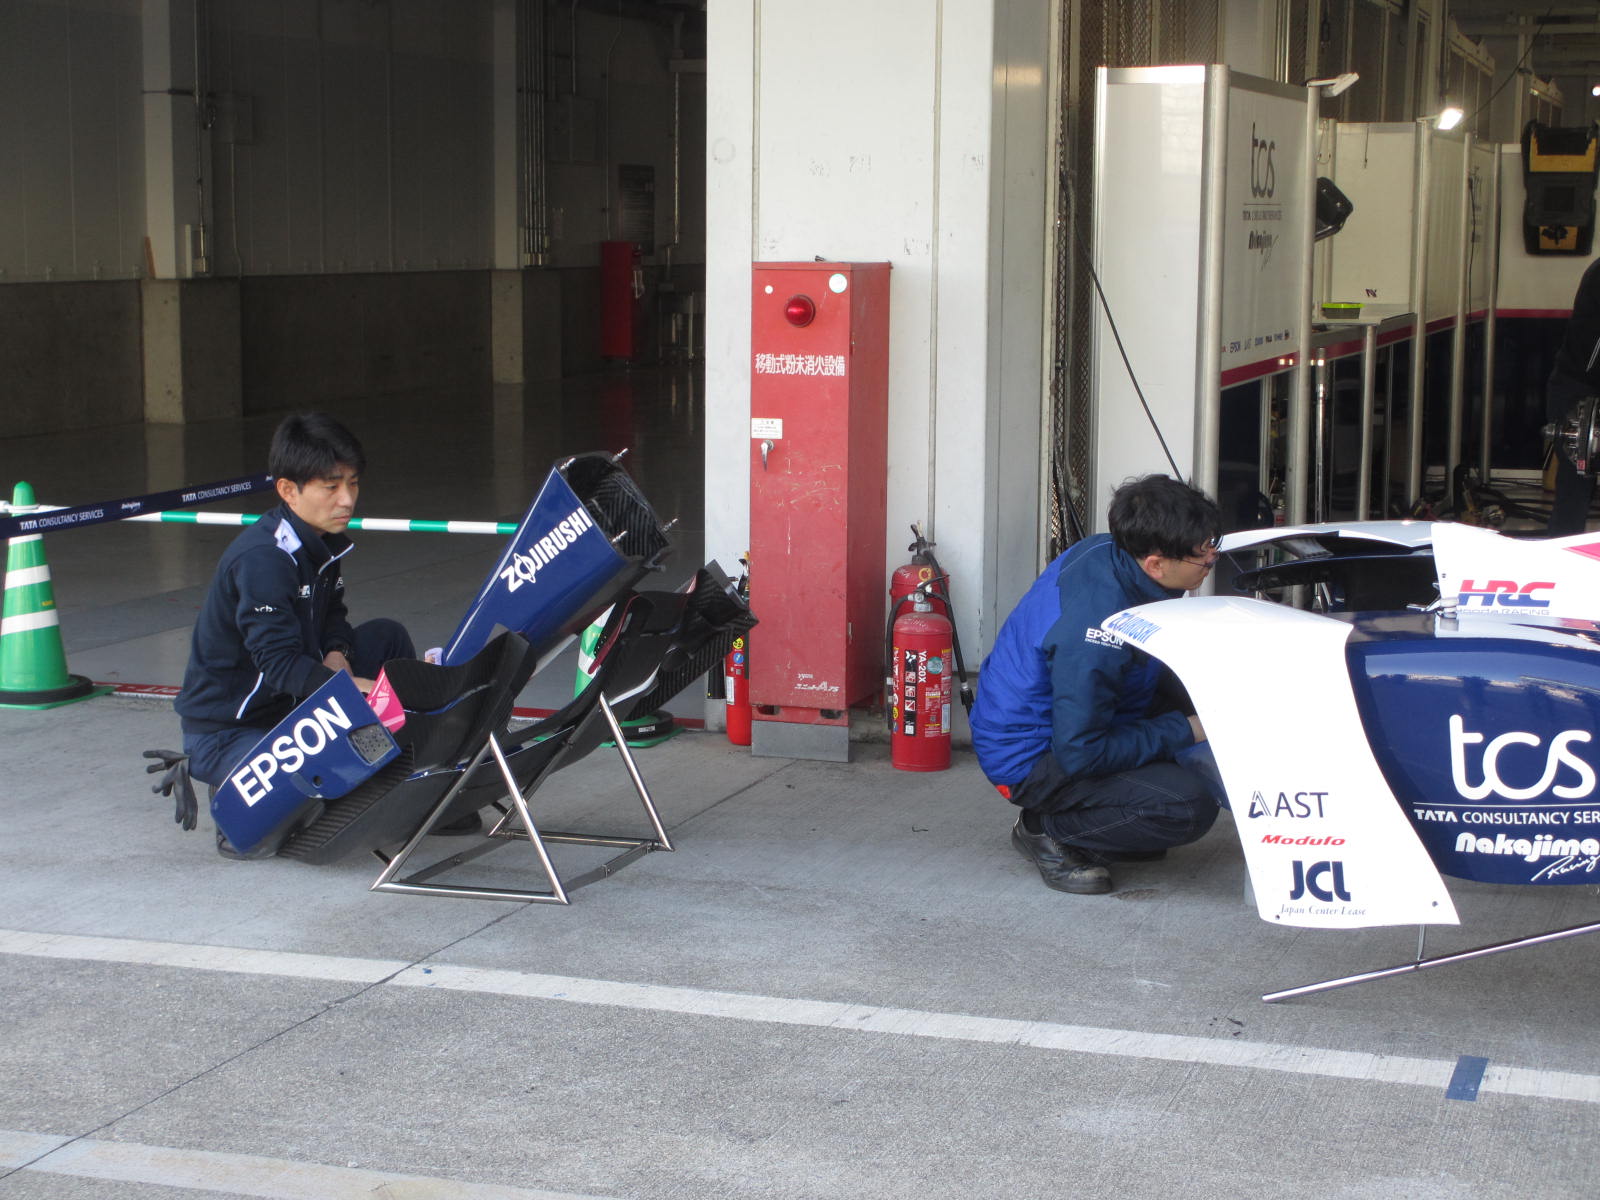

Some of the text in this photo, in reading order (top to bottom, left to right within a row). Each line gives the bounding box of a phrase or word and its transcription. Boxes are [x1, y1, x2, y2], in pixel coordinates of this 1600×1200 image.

[754, 353, 845, 376] 移動式粉末消火設備
[182, 481, 252, 502] TATA CONSULTANCY SERVICES
[20, 509, 104, 531] TATA CONSULTANCY SERVICES
[500, 507, 593, 593] ZOJIRUSHI
[1458, 580, 1556, 607] HRC
[918, 650, 927, 683] YA-20X
[231, 696, 352, 807] EPSON
[1449, 714, 1596, 800] tcs
[1414, 809, 1457, 822] TATA
[1462, 811, 1569, 825] CONSULTANCY
[1261, 835, 1346, 846] Modulo
[1455, 832, 1600, 862] Nakajima
[1290, 860, 1351, 902] JCL
[1281, 904, 1367, 916] Japan Center Lease
